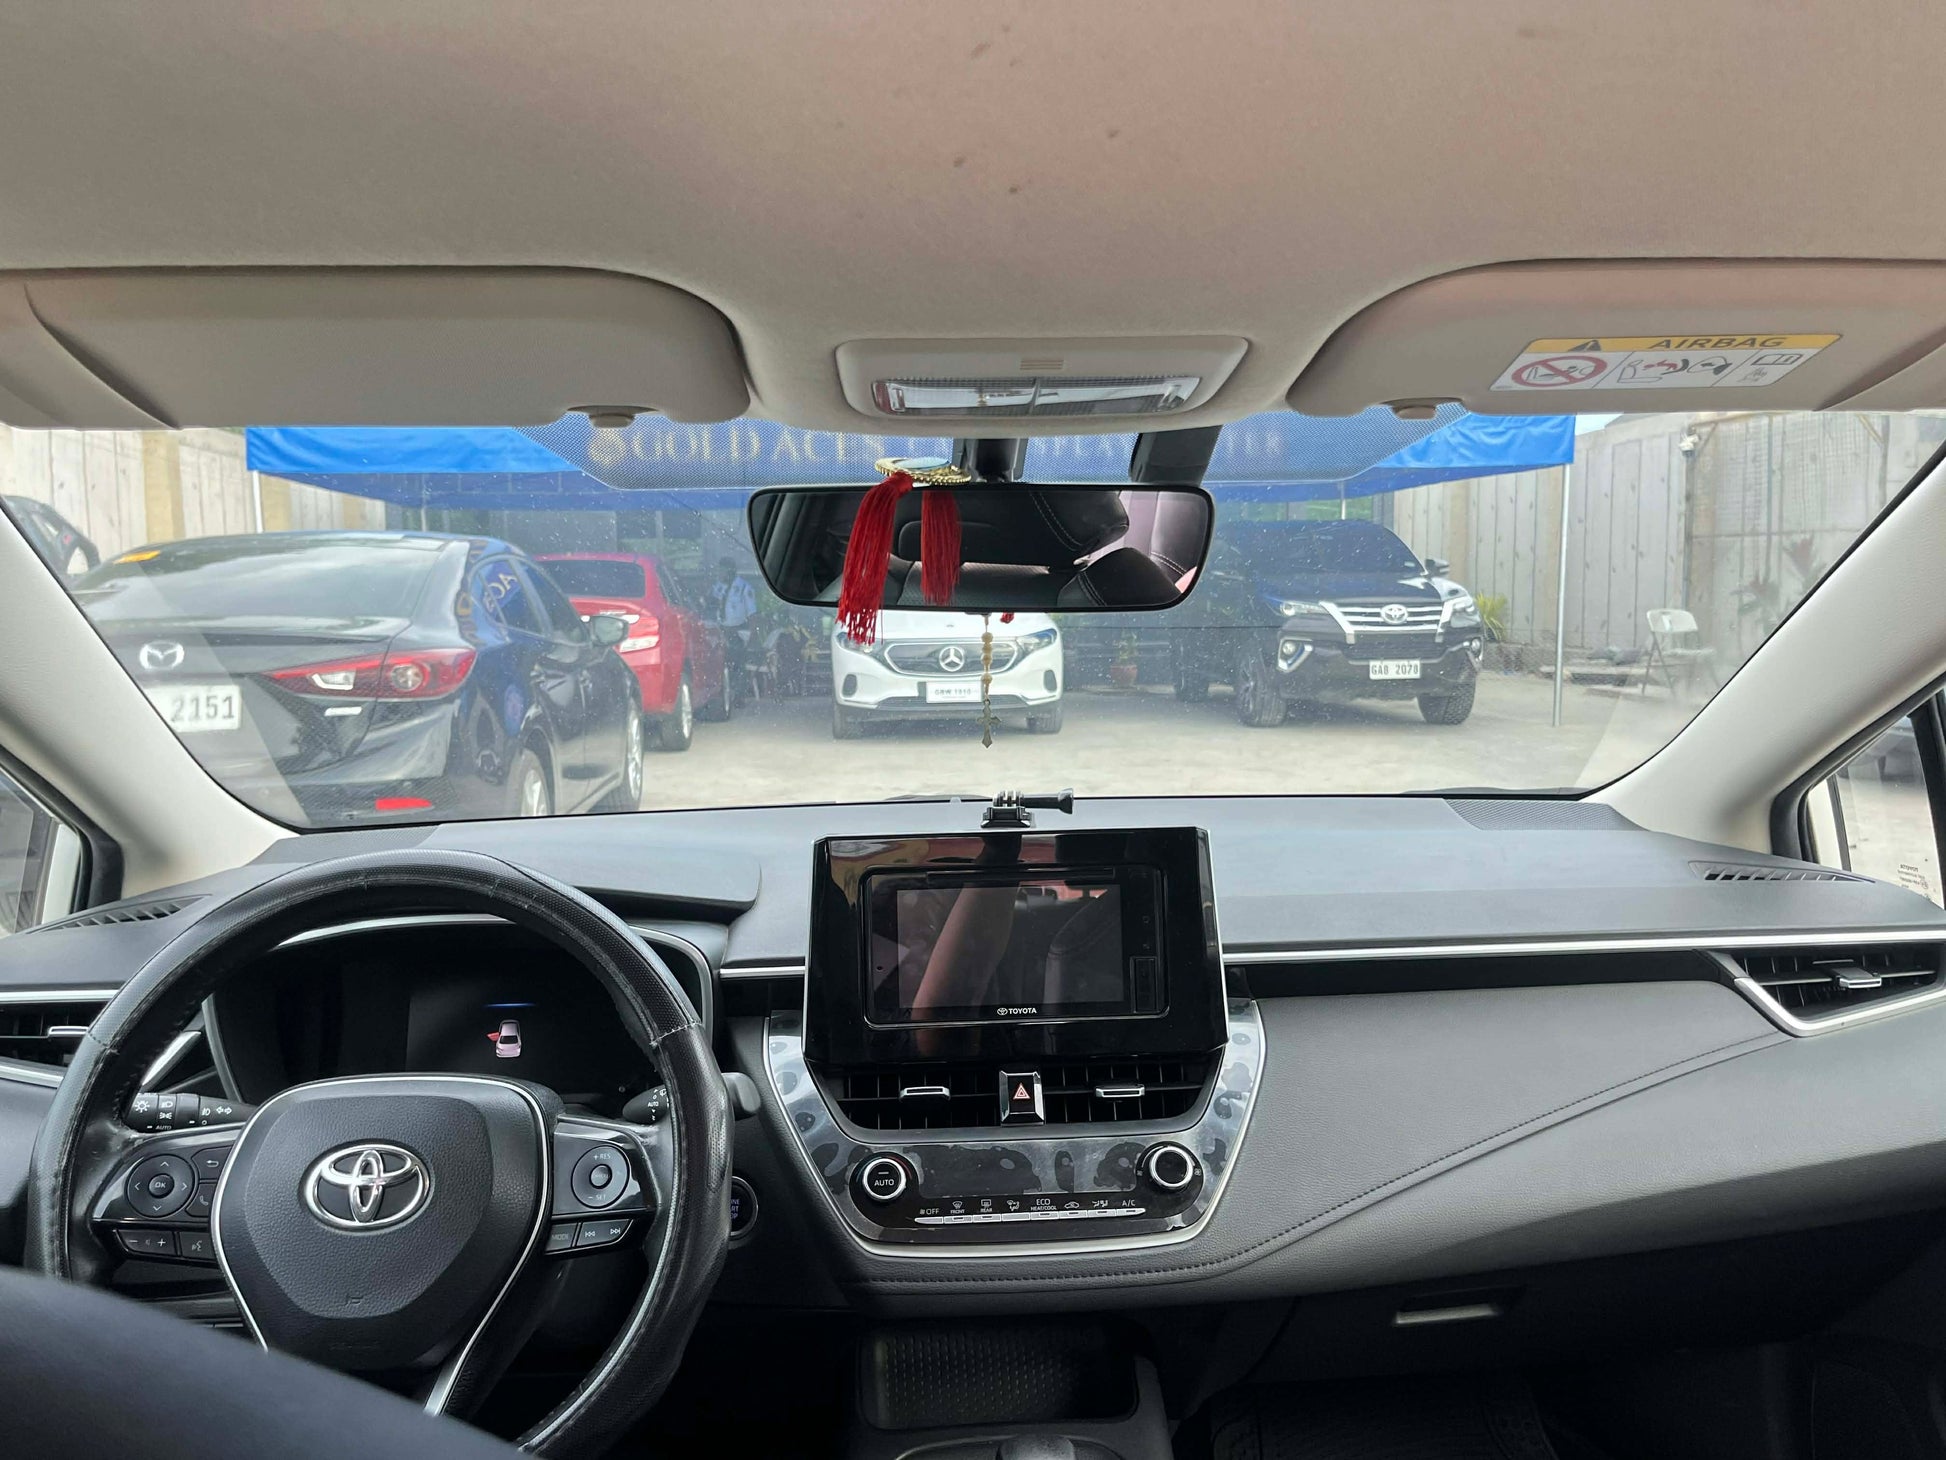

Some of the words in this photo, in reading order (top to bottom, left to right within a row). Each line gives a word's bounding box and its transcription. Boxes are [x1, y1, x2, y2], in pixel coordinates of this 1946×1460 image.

[1647, 337, 1787, 349] AIRBAG
[630, 426, 761, 462] GOLD
[170, 695, 235, 722] 2151
[1008, 1007, 1037, 1015] TOYOTA
[154, 1181, 167, 1189] OK
[874, 1178, 895, 1187] AUTO
[1036, 1198, 1051, 1206] ECO
[1121, 1199, 1136, 1207] A/C
